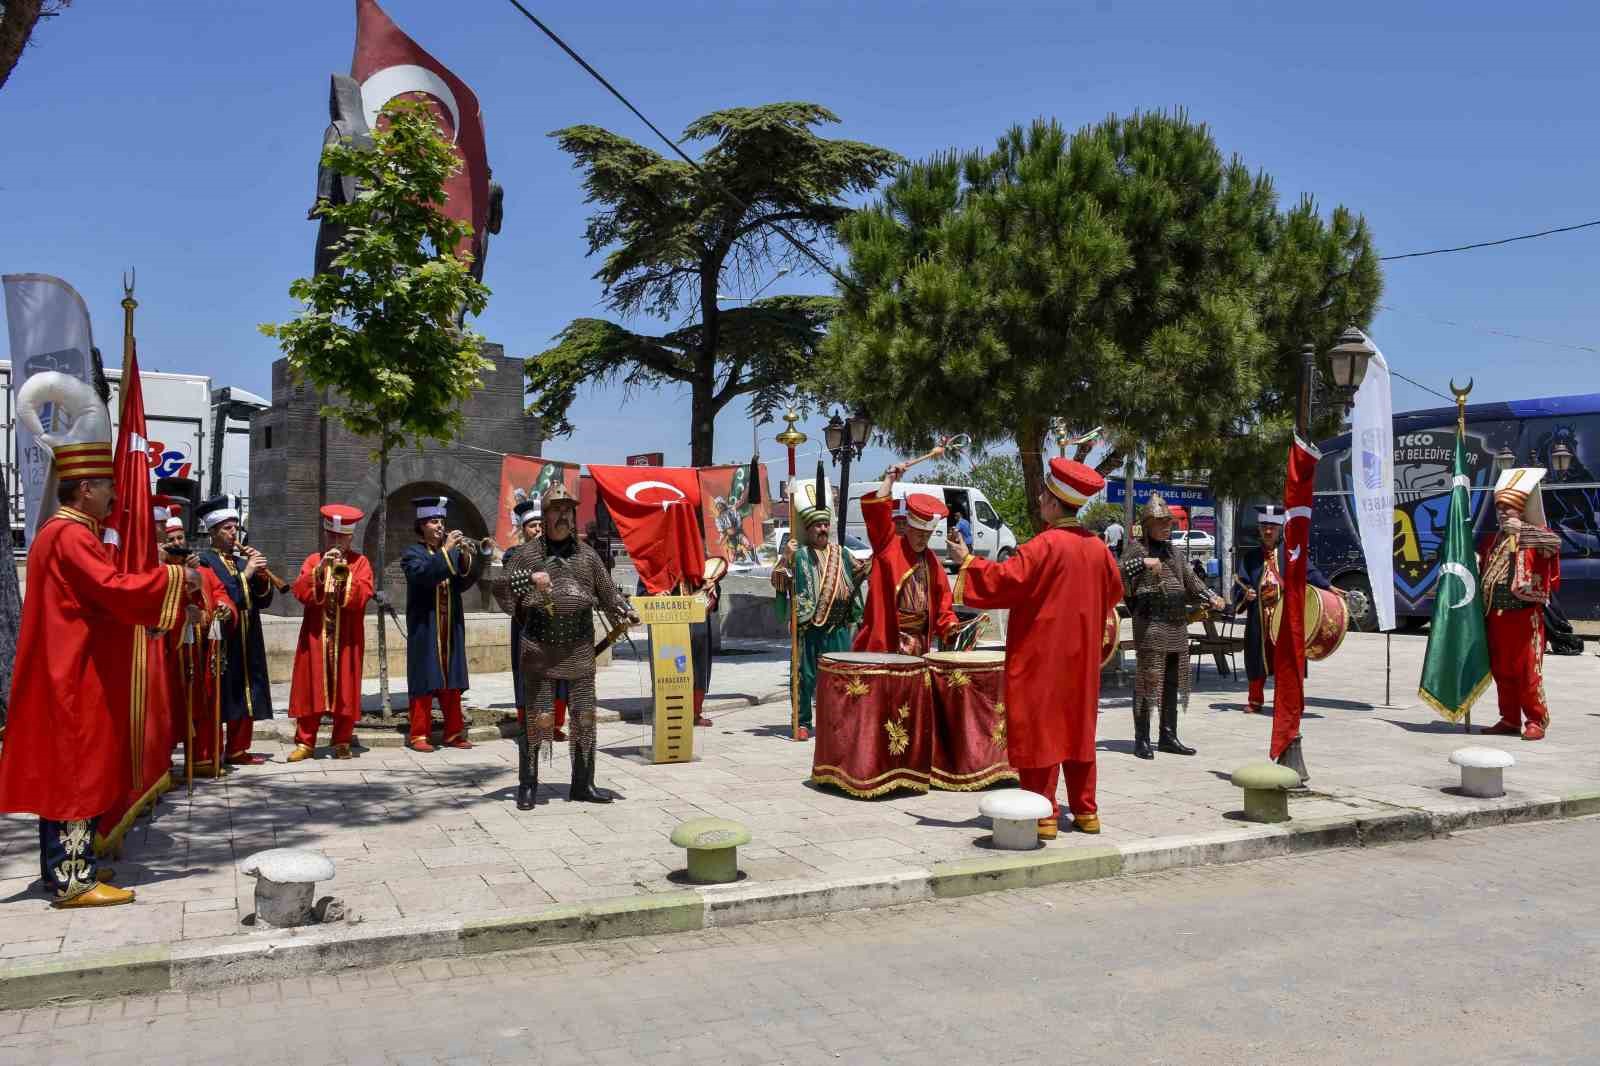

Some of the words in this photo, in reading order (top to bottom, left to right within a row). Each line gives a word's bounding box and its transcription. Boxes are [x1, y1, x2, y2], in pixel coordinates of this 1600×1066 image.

[1397, 433, 1434, 447] TECO
[1407, 447, 1451, 461] BELEDİYE
[644, 600, 692, 610] KARACABEY
